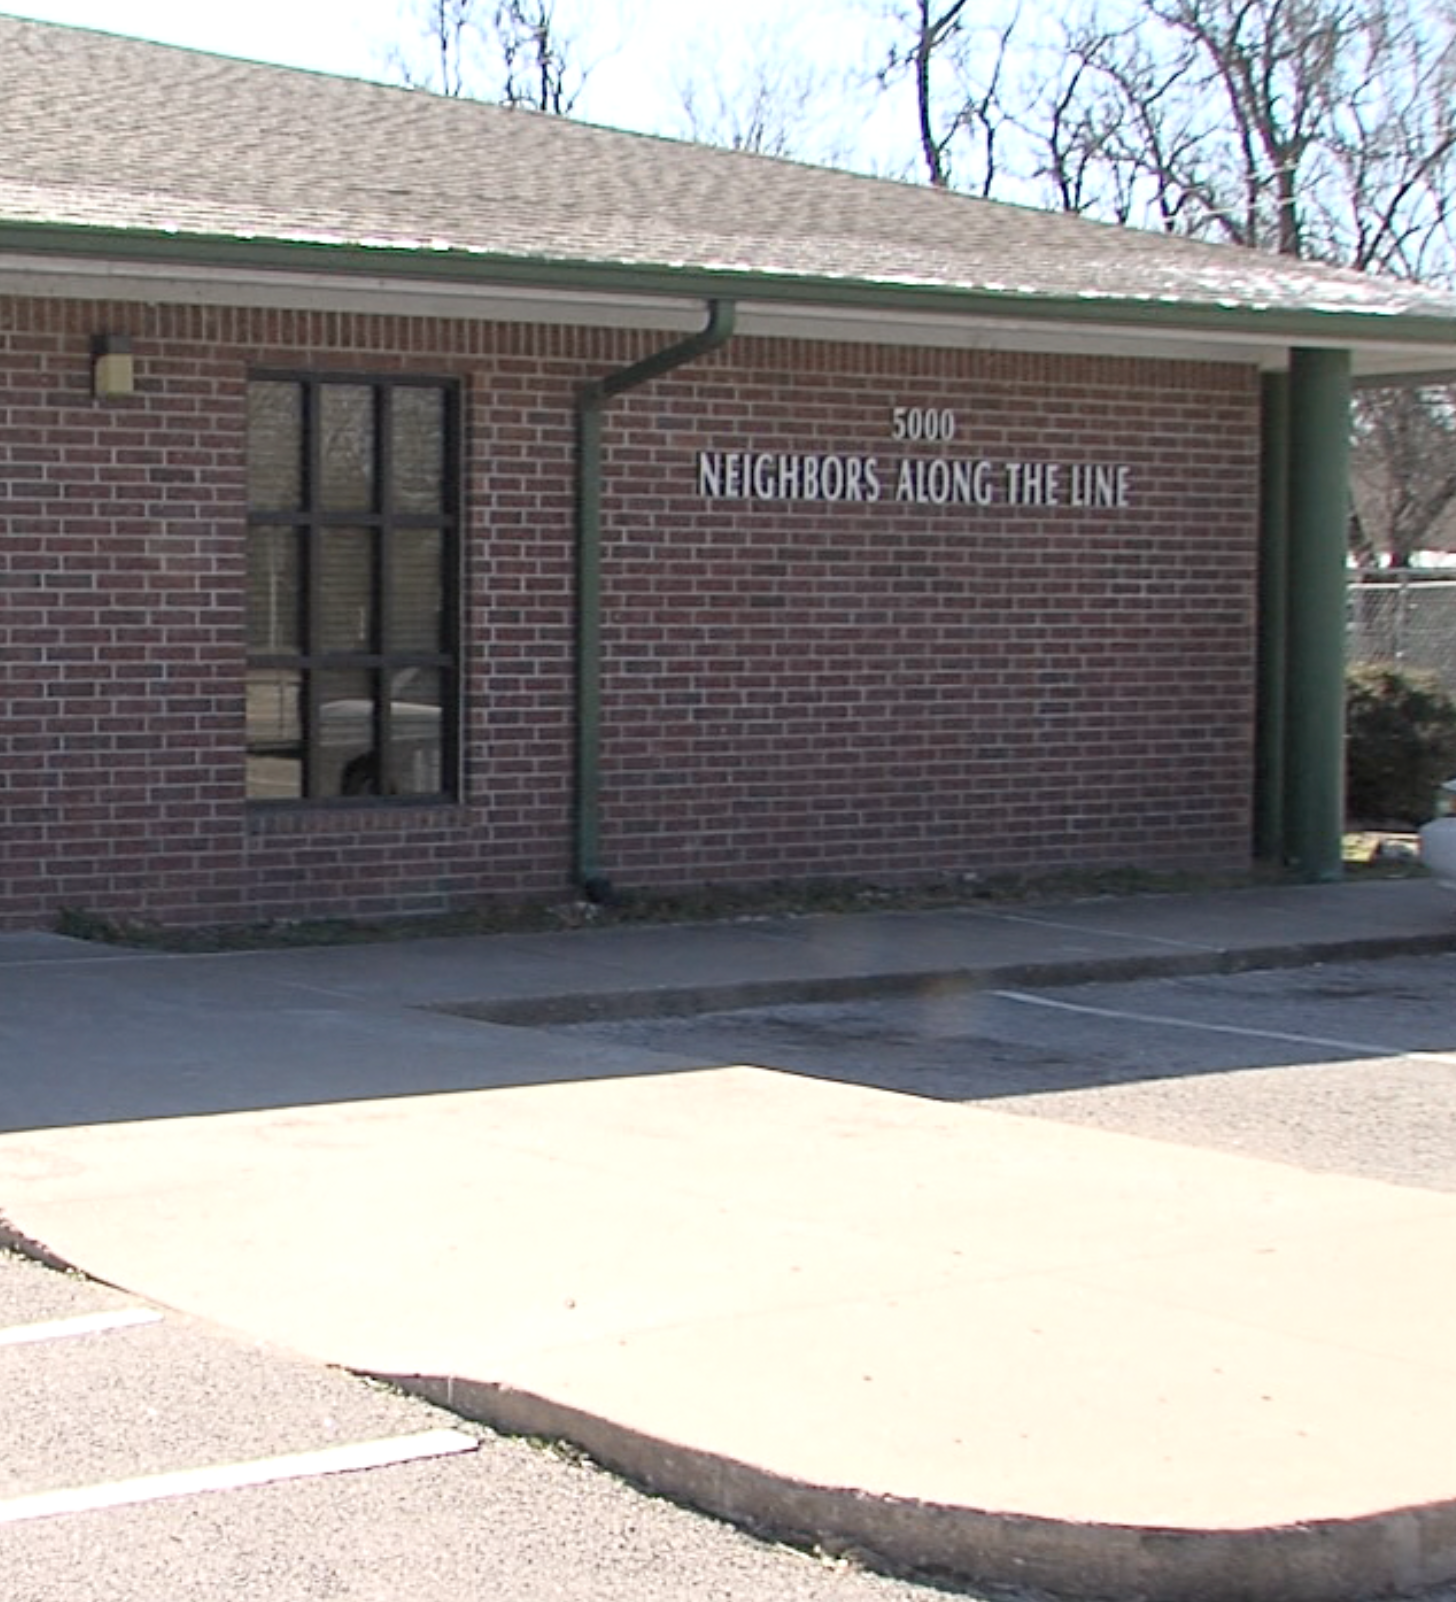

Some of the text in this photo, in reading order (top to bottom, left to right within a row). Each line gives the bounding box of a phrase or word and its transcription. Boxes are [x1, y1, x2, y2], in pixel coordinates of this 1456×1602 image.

[892, 407, 955, 440] 5000
[699, 452, 1131, 507] NEIGHBORS ALONG THE LINE
